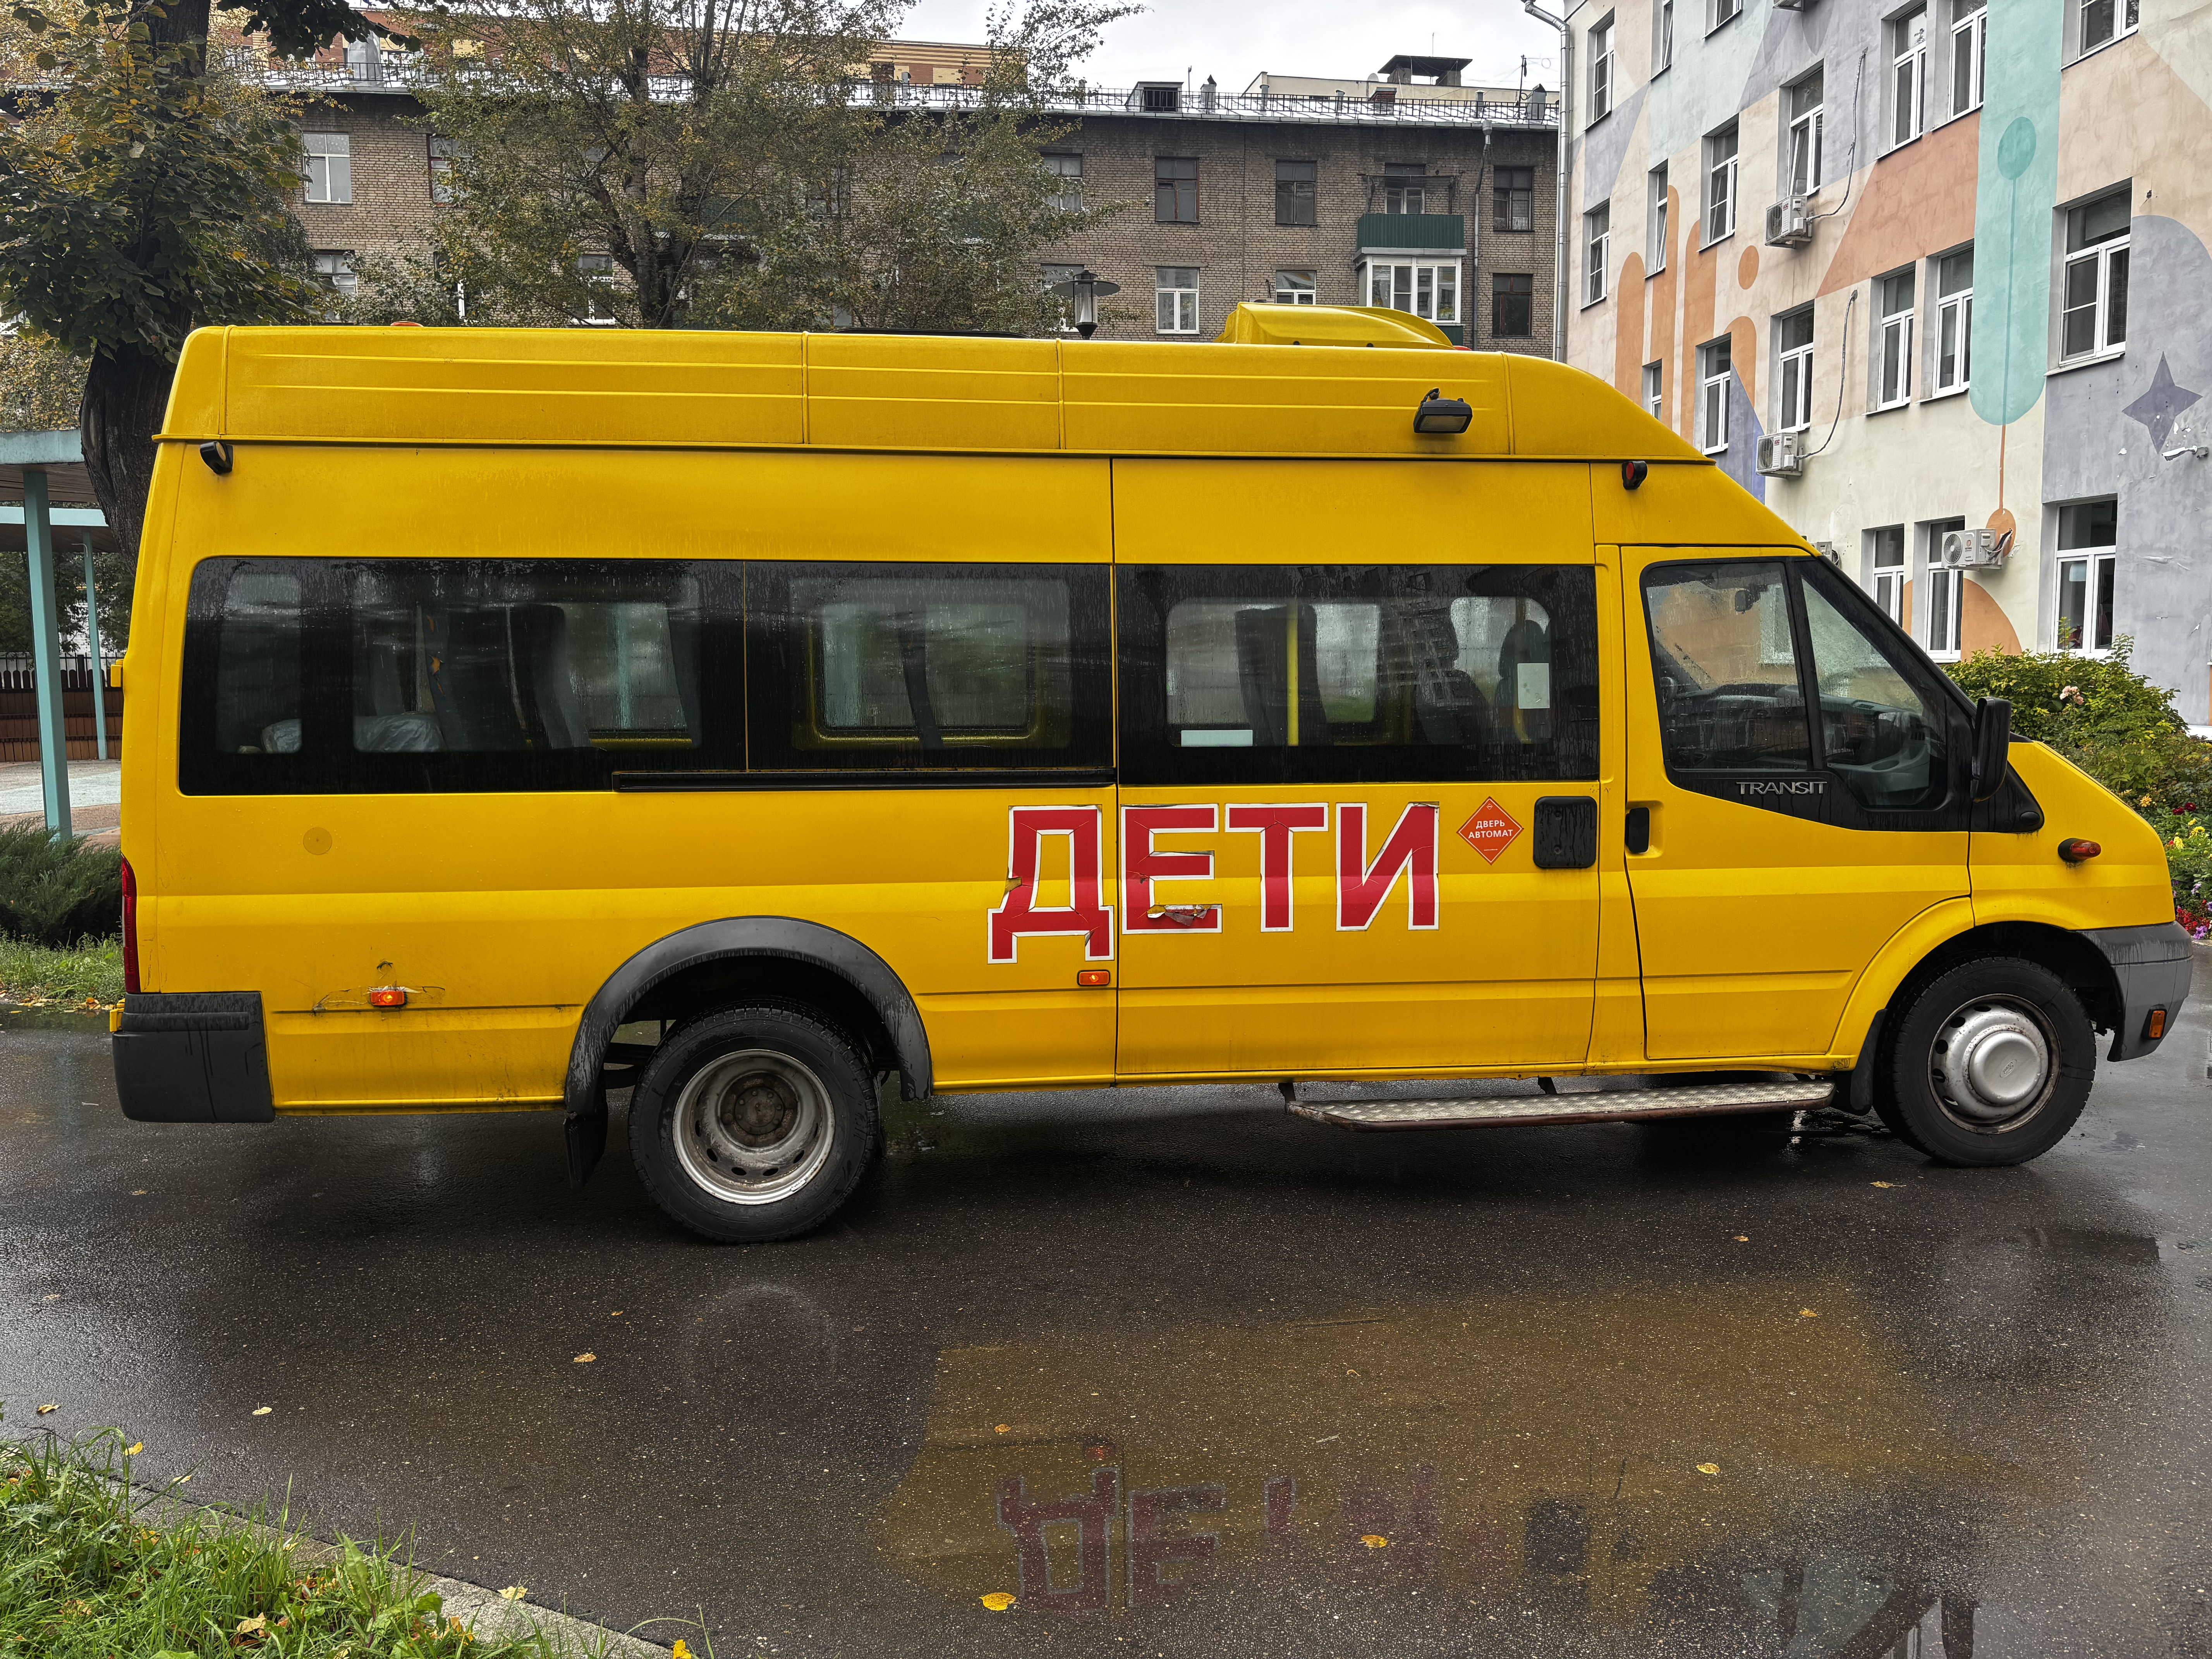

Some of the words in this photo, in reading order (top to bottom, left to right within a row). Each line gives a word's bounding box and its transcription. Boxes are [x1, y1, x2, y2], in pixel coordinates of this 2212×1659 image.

[1736, 781, 1827, 794] TRANSIT
[1476, 820, 1505, 829] ДВЕРЬ
[1468, 829, 1513, 839] АВТОМАТ
[988, 803, 1439, 963] ДЕТИ
